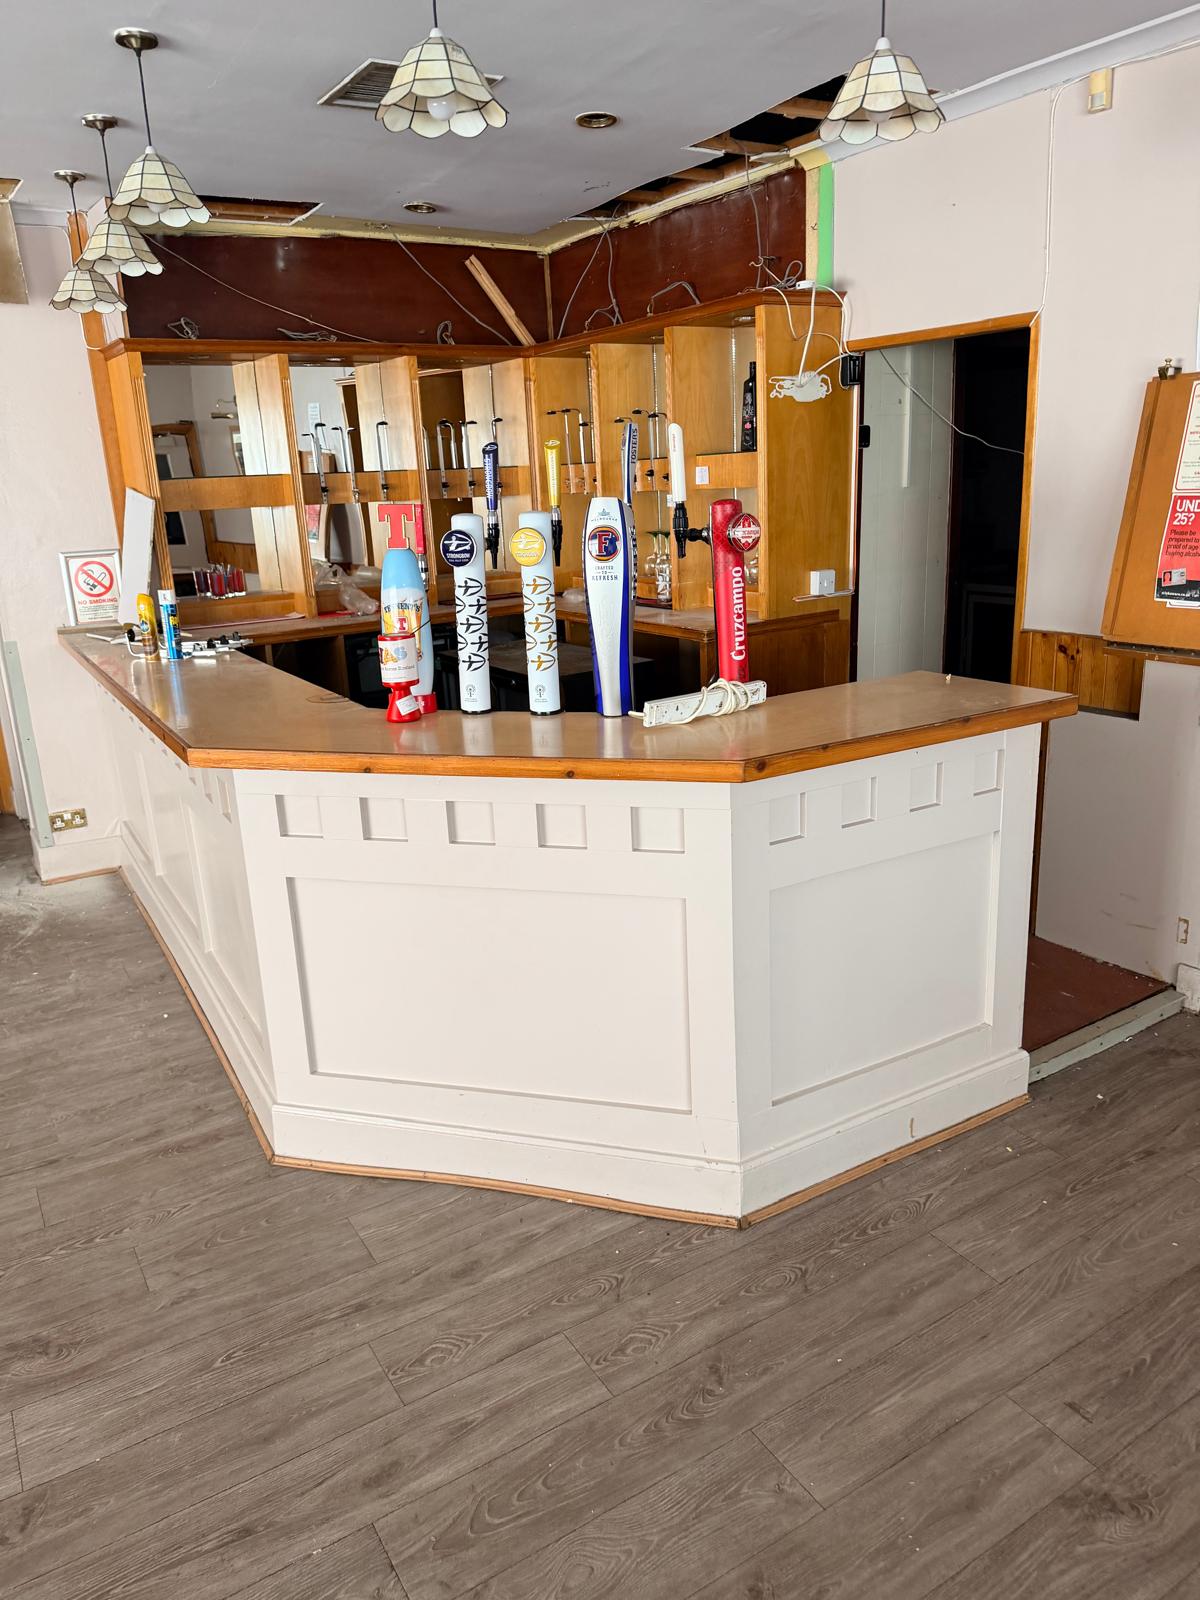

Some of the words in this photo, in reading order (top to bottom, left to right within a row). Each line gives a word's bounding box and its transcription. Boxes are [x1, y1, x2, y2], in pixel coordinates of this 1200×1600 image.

[1172, 512, 1196, 526] 25?
[377, 503, 415, 549] T
[1169, 529, 1188, 537] Please
[596, 532, 612, 556] F
[1167, 536, 1193, 546] prepared
[1167, 543, 1182, 553] proof
[1182, 543, 1188, 551] of
[1188, 545, 1199, 553] age
[591, 574, 618, 582] REFRESH
[730, 566, 746, 661] Cruzcampo
